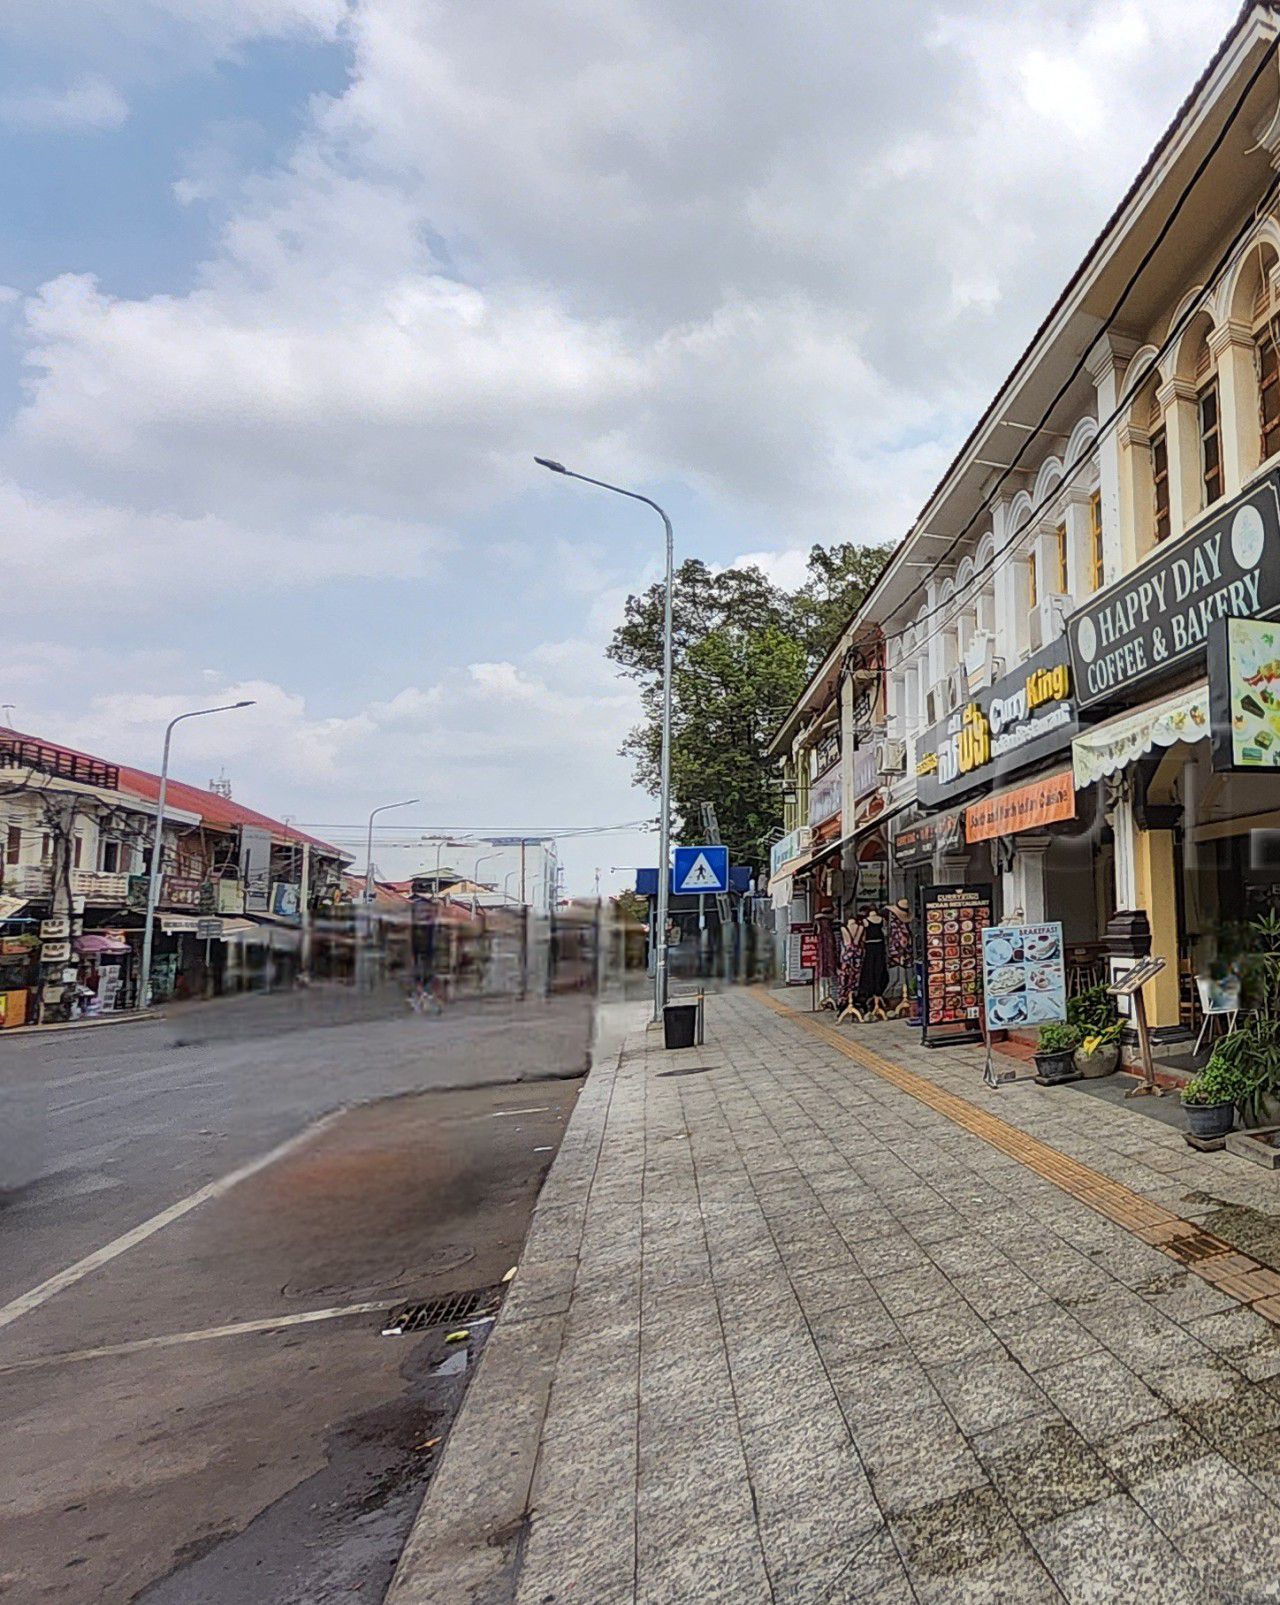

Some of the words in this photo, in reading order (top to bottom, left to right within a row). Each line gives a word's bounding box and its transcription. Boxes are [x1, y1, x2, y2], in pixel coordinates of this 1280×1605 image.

[1087, 637, 1148, 694] COFFEE
[1152, 626, 1169, 662] &
[1171, 568, 1262, 652] BAKERY
[1097, 569, 1167, 647] HAPPY
[1171, 532, 1223, 603] DAY
[1027, 663, 1069, 709] King
